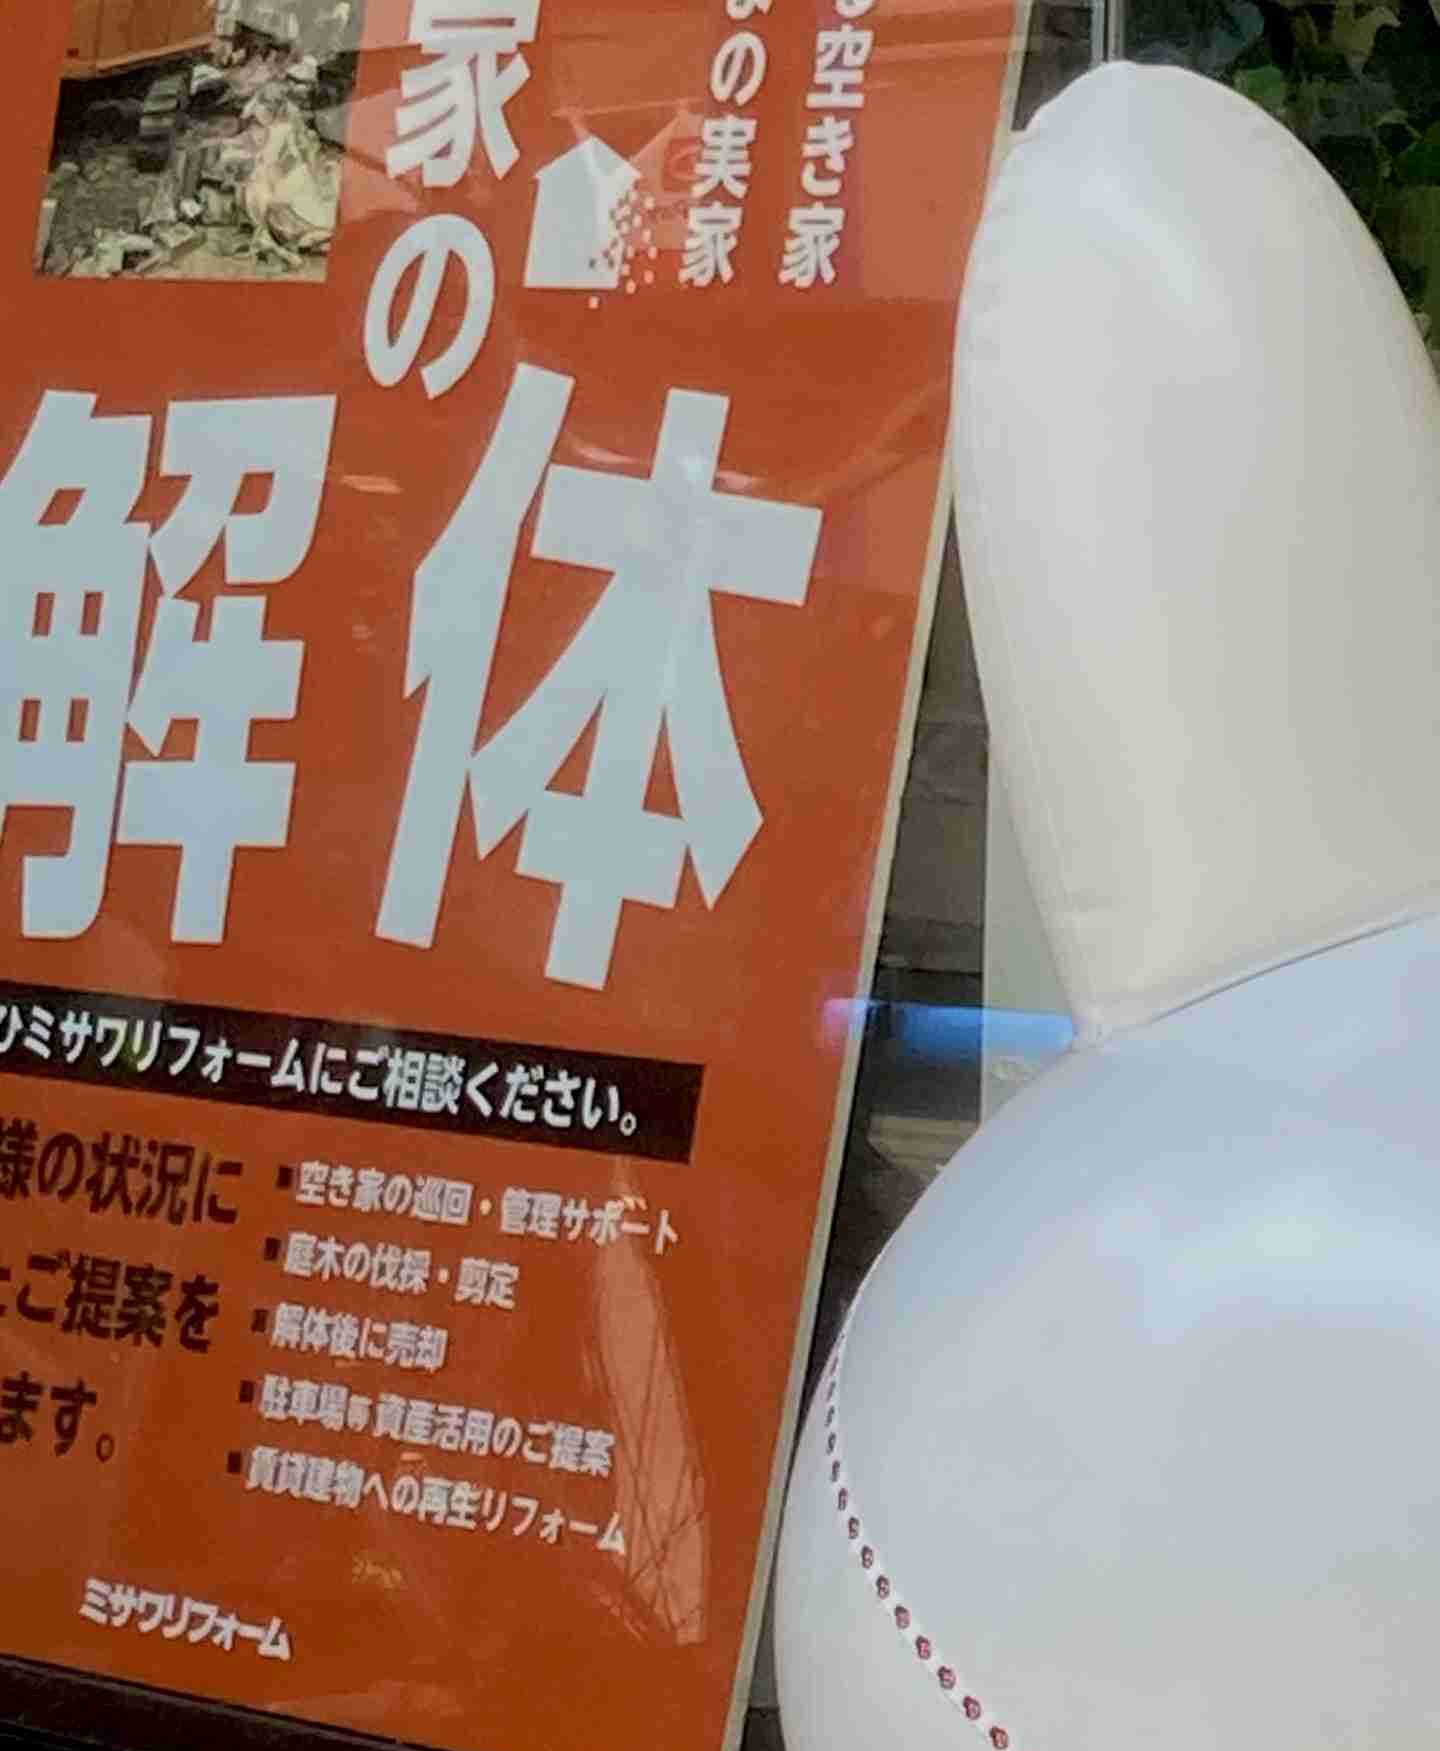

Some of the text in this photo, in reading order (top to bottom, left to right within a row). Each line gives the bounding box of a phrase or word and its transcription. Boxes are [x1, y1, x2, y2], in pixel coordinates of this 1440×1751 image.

[0, 361, 823, 991] 解体
[271, 1302, 449, 1373] 解体後に売却
[0, 1370, 115, 1463] ます。
[79, 1576, 292, 1661] ミサワリフォーム
